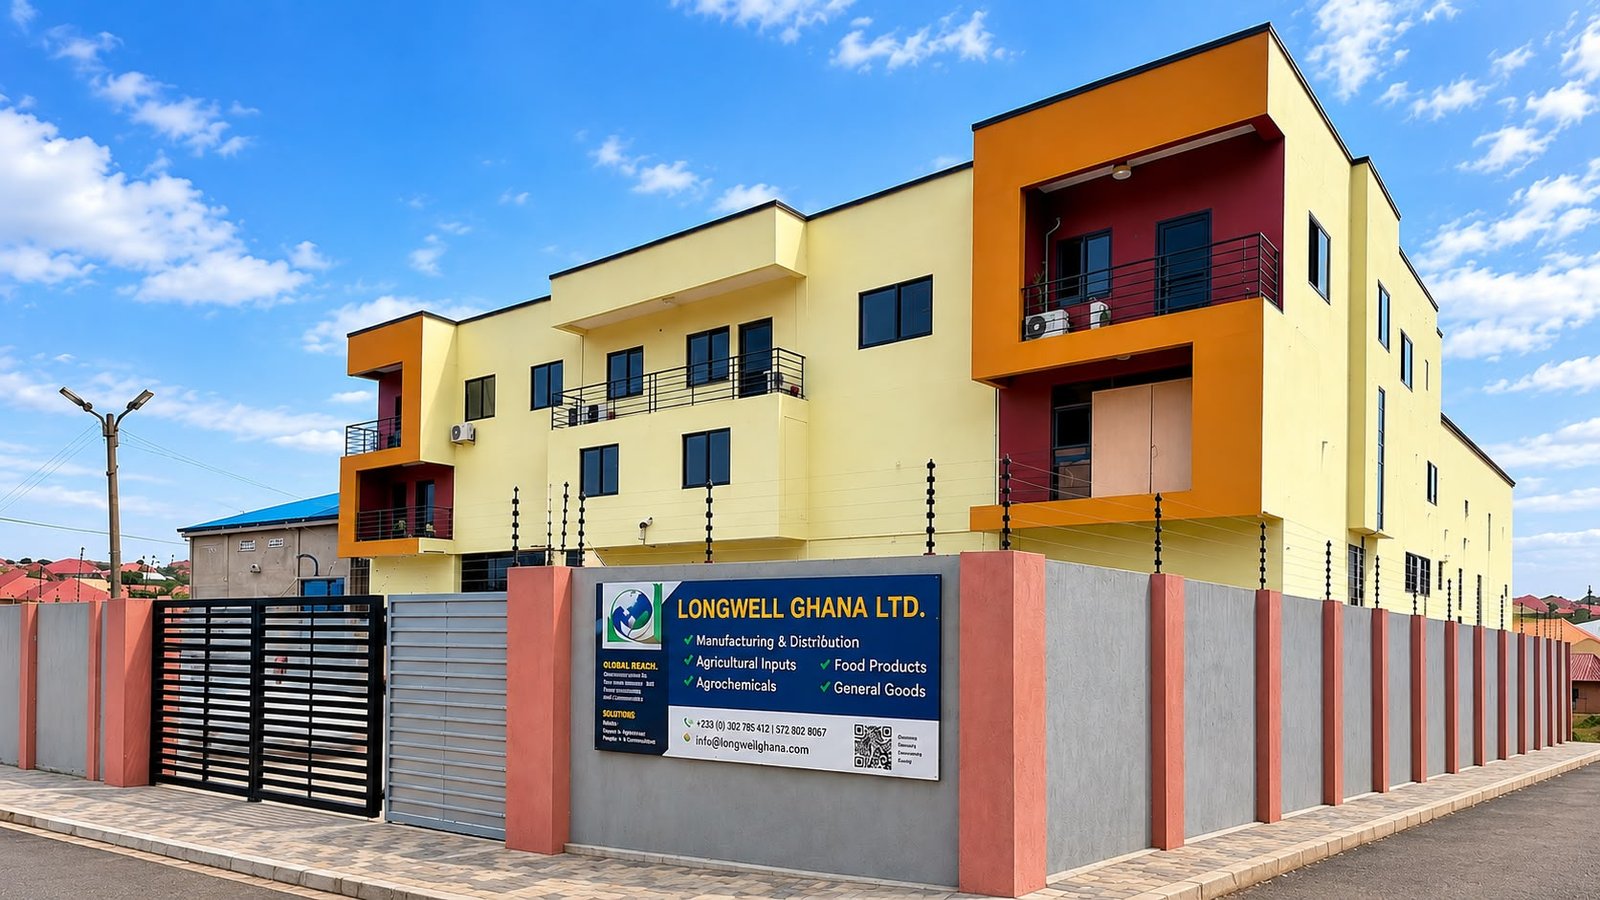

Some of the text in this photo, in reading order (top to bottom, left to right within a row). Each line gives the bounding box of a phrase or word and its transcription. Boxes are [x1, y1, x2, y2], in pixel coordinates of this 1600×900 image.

[678, 595, 926, 619] LONGWELL GHANA LTD.
[696, 634, 860, 651] Manufacturing & Distribution
[696, 655, 797, 674] Agricultural Inputs
[834, 658, 927, 674] Food Products
[696, 676, 777, 692] Agrochemicals
[834, 681, 926, 698] General Goods
[697, 719, 714, 729] +233
[715, 719, 726, 732] (0)
[727, 721, 741, 731] 302
[756, 723, 770, 734] 412
